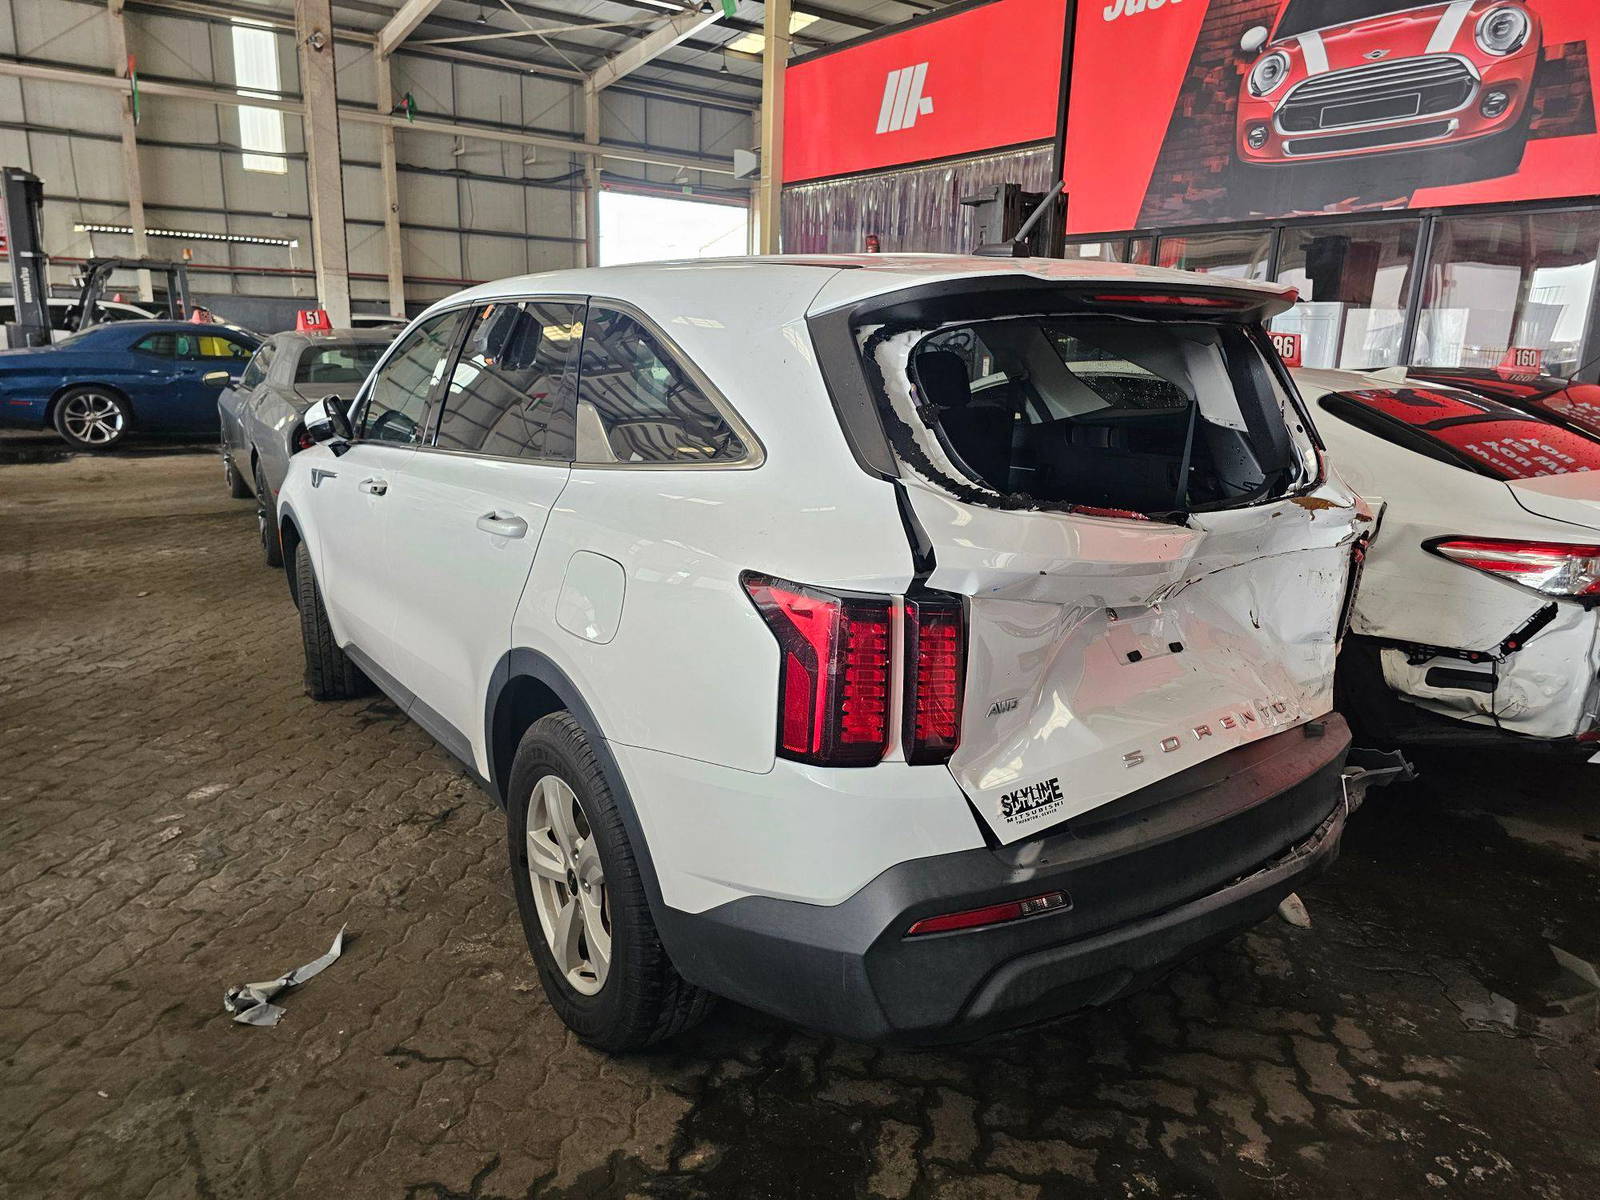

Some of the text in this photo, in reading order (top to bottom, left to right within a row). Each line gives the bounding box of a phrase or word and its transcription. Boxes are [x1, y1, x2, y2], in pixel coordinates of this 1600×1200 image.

[305, 311, 320, 325] 51
[1269, 335, 1294, 358] 96
[1516, 350, 1536, 366] 160
[1121, 701, 1288, 768] SORENTO
[1000, 777, 1064, 818] SKYLINE
[1006, 800, 1064, 823] MITSUBISHI
